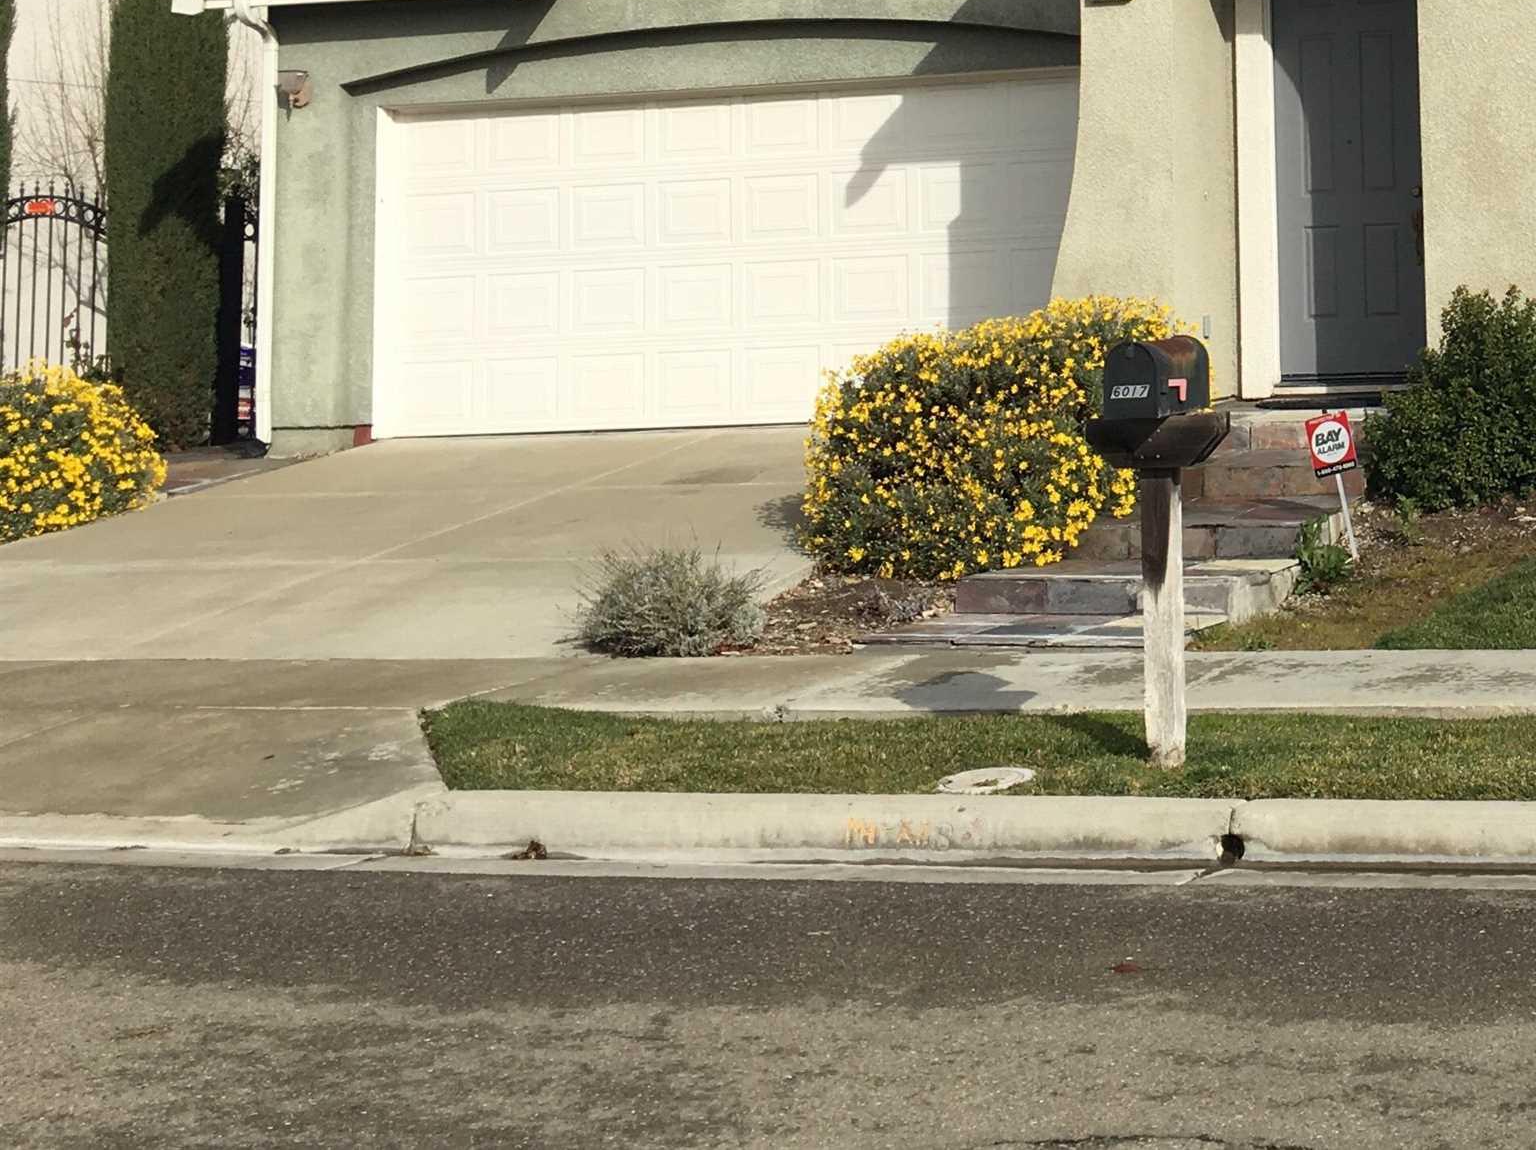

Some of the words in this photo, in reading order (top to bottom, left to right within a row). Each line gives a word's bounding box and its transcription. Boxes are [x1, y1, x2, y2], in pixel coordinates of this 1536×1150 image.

[1112, 386, 1148, 398] 6017
[1315, 427, 1342, 447] BAY
[1317, 442, 1345, 454] ALARM
